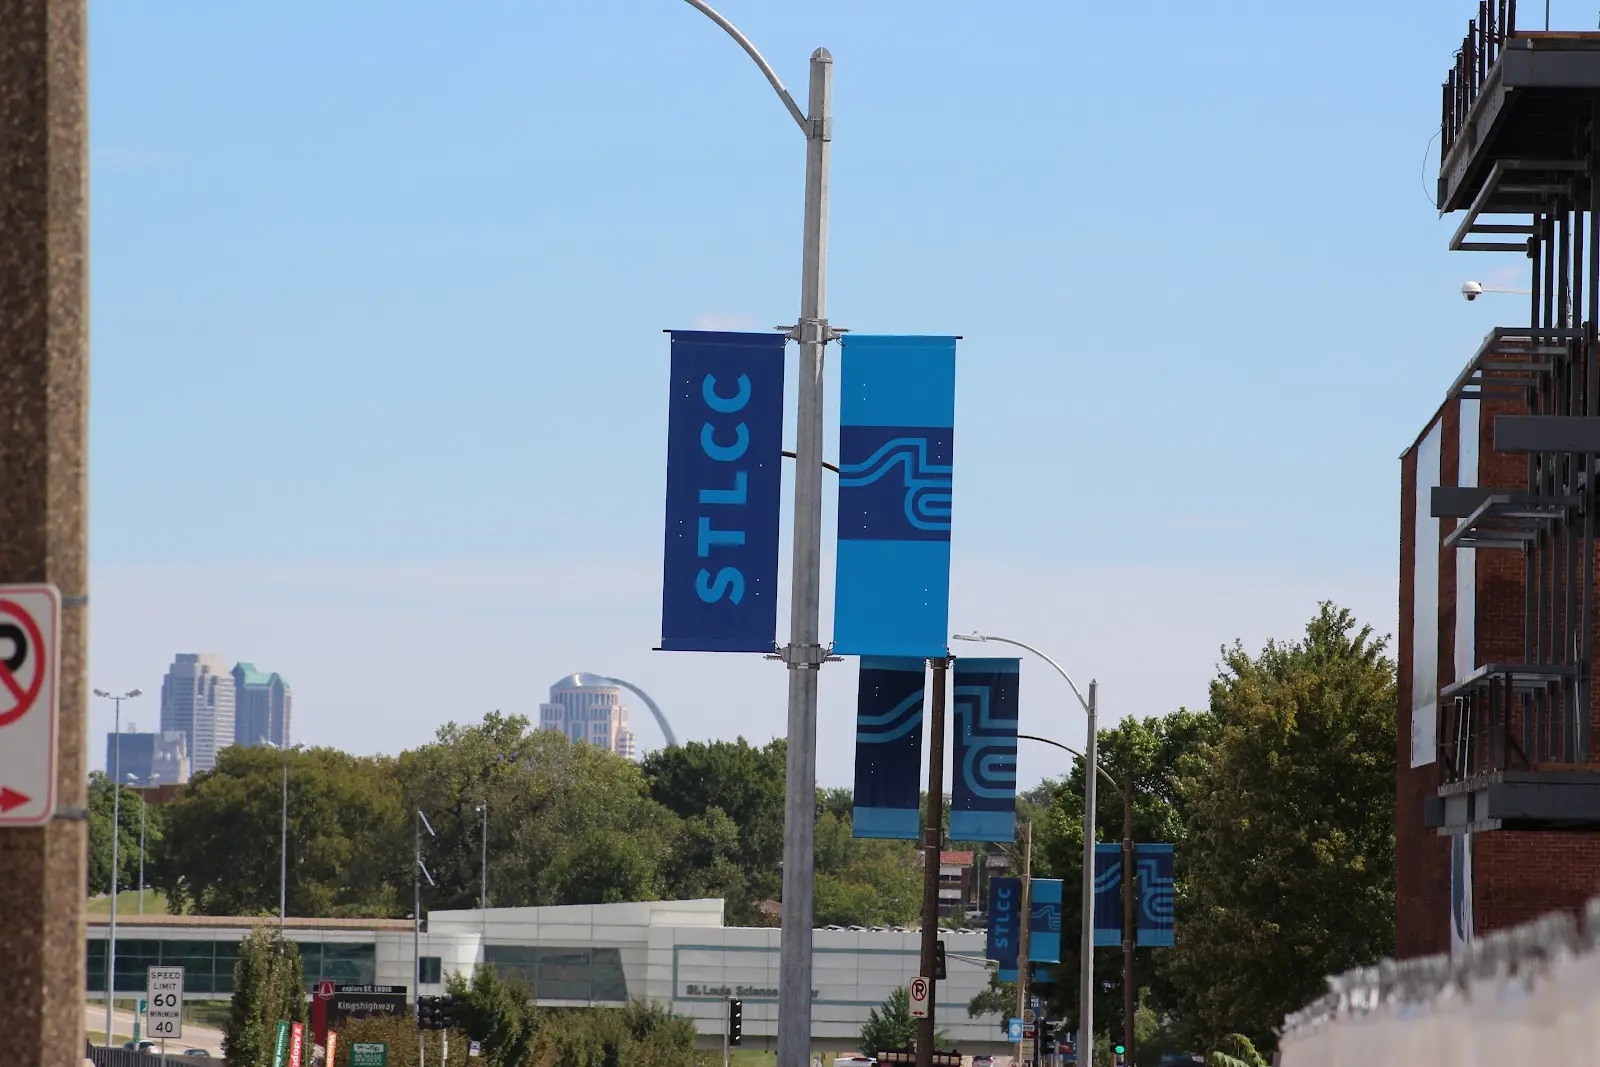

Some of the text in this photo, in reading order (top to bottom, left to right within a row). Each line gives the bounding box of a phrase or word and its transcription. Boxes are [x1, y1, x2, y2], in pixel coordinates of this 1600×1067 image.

[695, 373, 751, 605] STLCC
[995, 886, 1011, 948] STLCC
[151, 971, 181, 980] SPEED
[687, 984, 778, 997] St. Louis Science
[154, 994, 177, 1007] 60
[337, 1001, 395, 1012] Kingshighway
[150, 1011, 180, 1019] MINIMUM
[155, 1021, 173, 1033] 40
